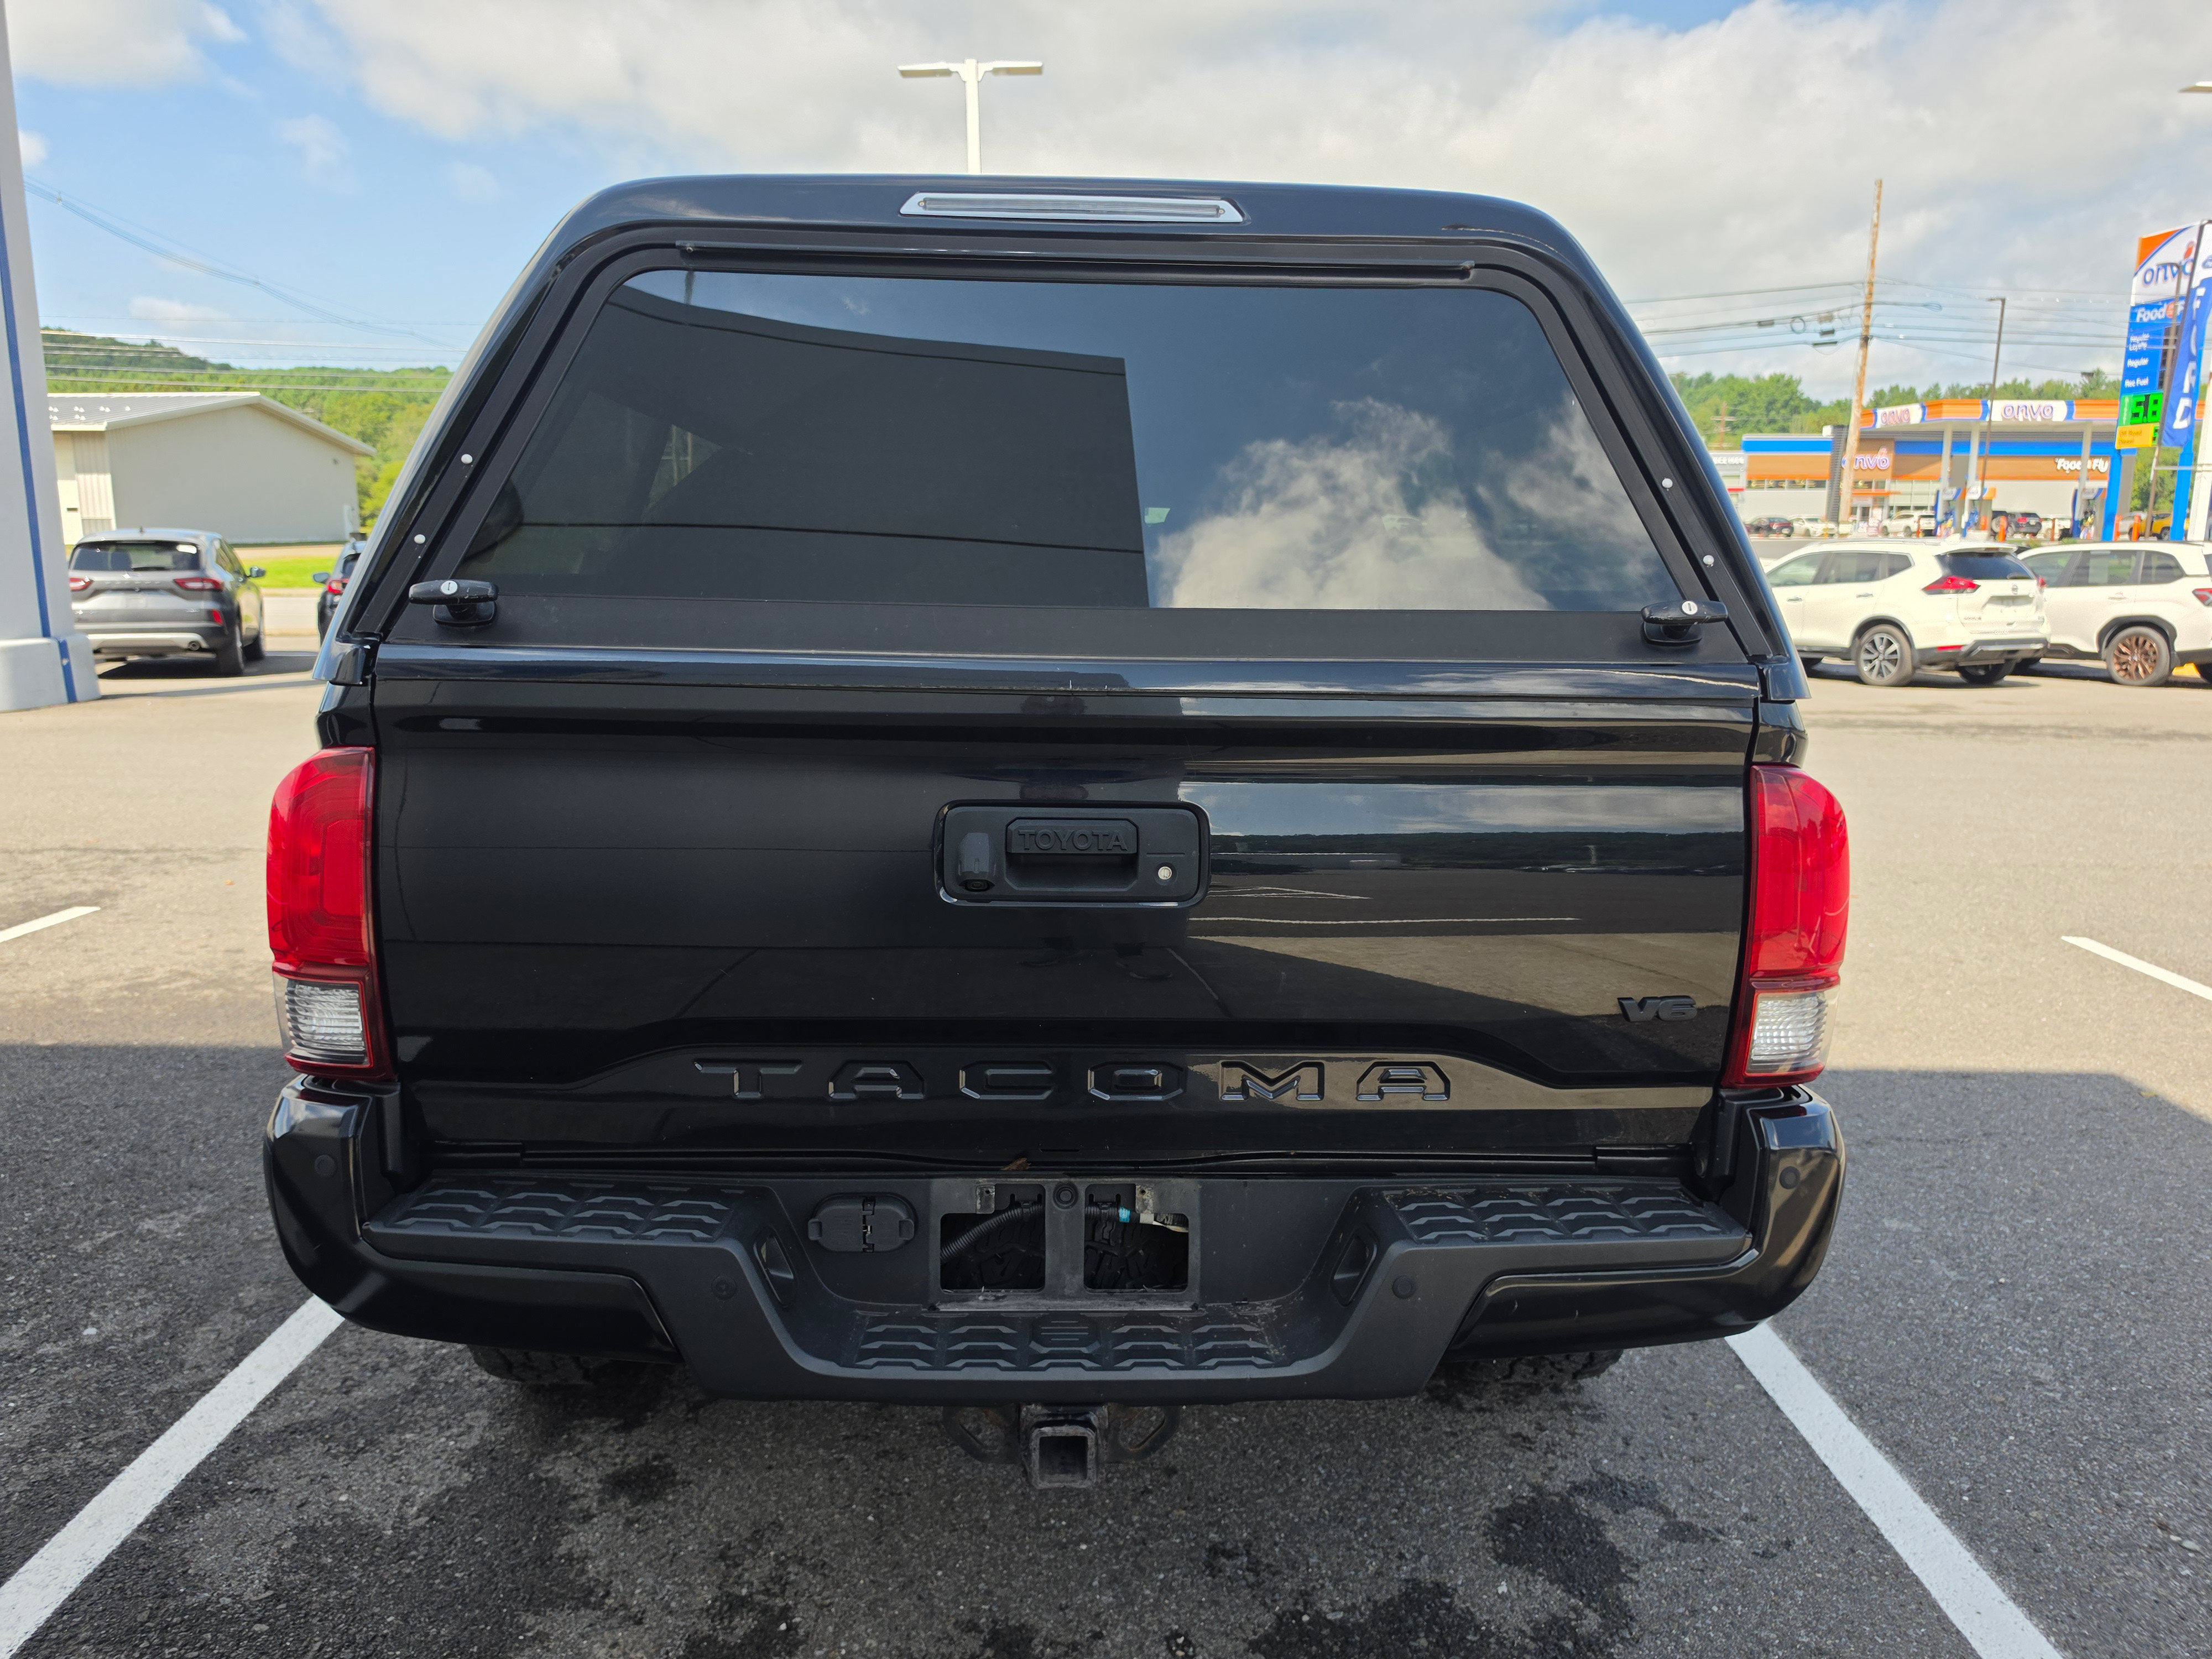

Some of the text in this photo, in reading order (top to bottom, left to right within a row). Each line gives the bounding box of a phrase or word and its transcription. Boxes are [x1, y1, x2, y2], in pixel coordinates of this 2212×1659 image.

[2144, 259, 2193, 284] onvo
[2136, 302, 2166, 322] Food
[2127, 357, 2149, 368] Regular
[2136, 377, 2149, 386] Fuel
[1881, 408, 1910, 425] onvo
[2001, 404, 2054, 419] onvo
[1019, 830, 1128, 851] TOYOTA
[1617, 995, 1698, 1022] V6
[693, 1058, 1451, 1101] TACOMA
